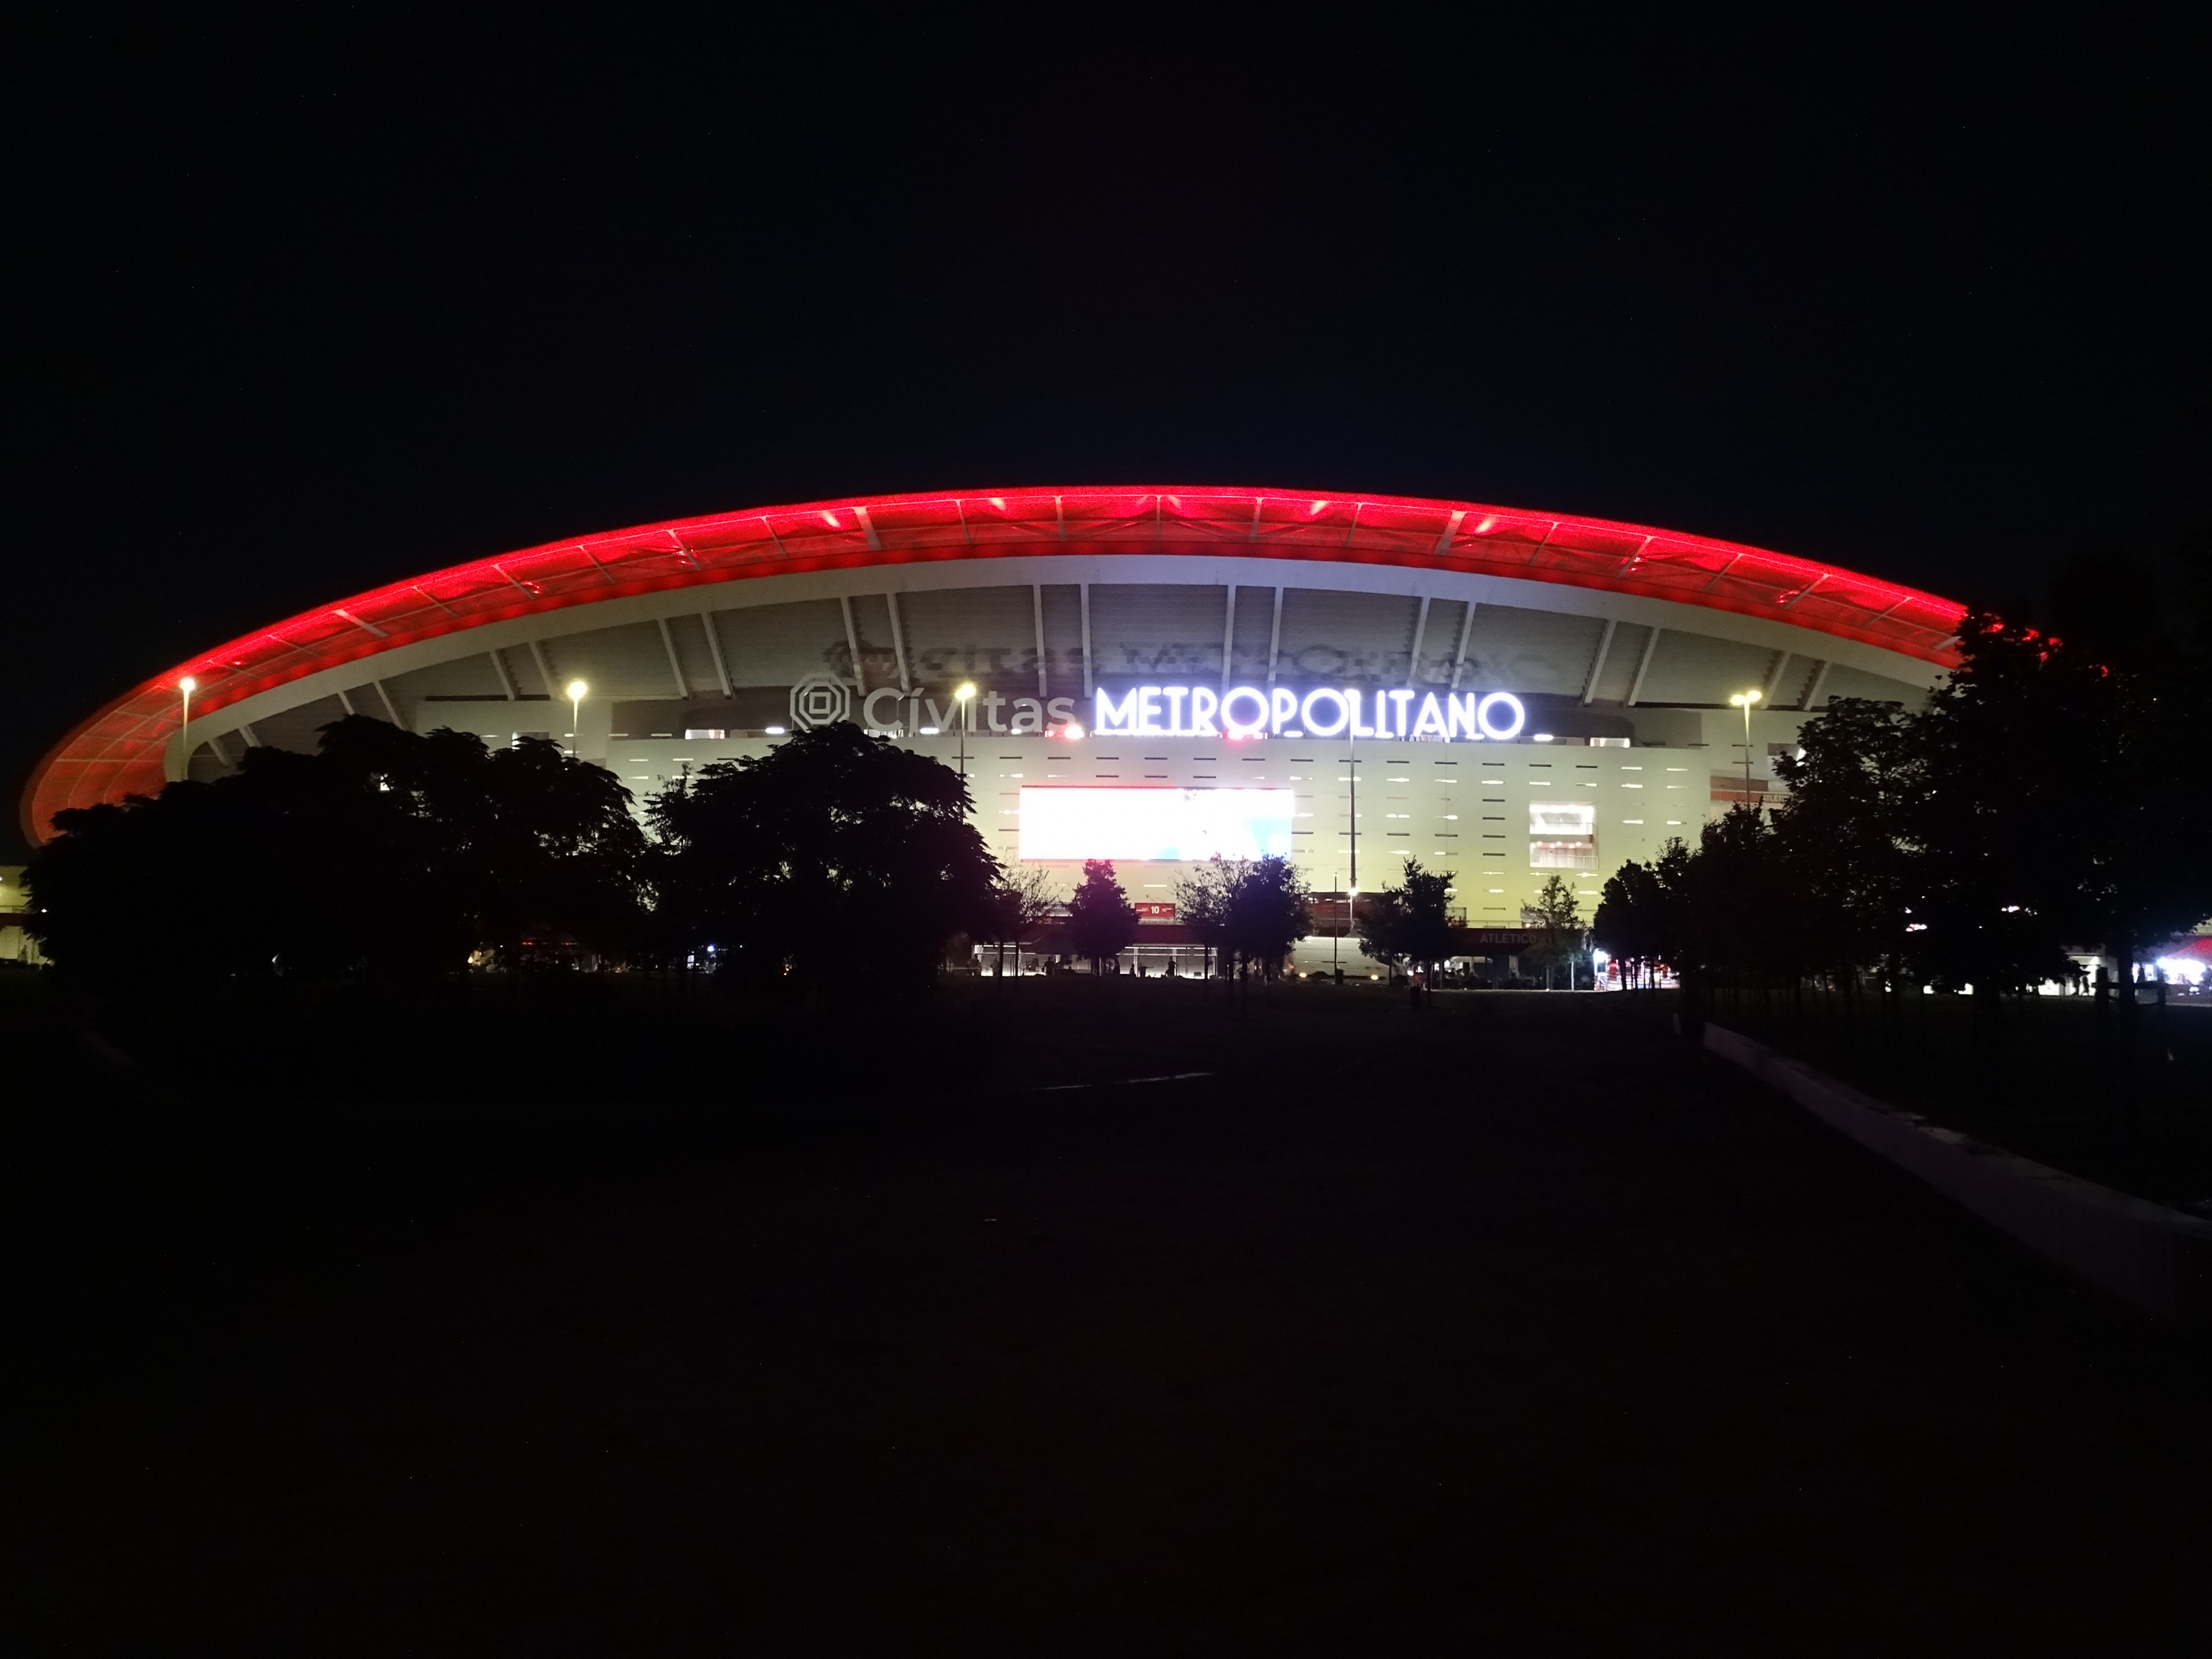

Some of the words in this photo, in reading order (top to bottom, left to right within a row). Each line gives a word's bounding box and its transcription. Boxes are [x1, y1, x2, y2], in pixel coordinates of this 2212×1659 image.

[864, 687, 1076, 734] Cívitas
[1095, 686, 1525, 740] METROPOLITANO
[1151, 906, 1160, 914] 10
